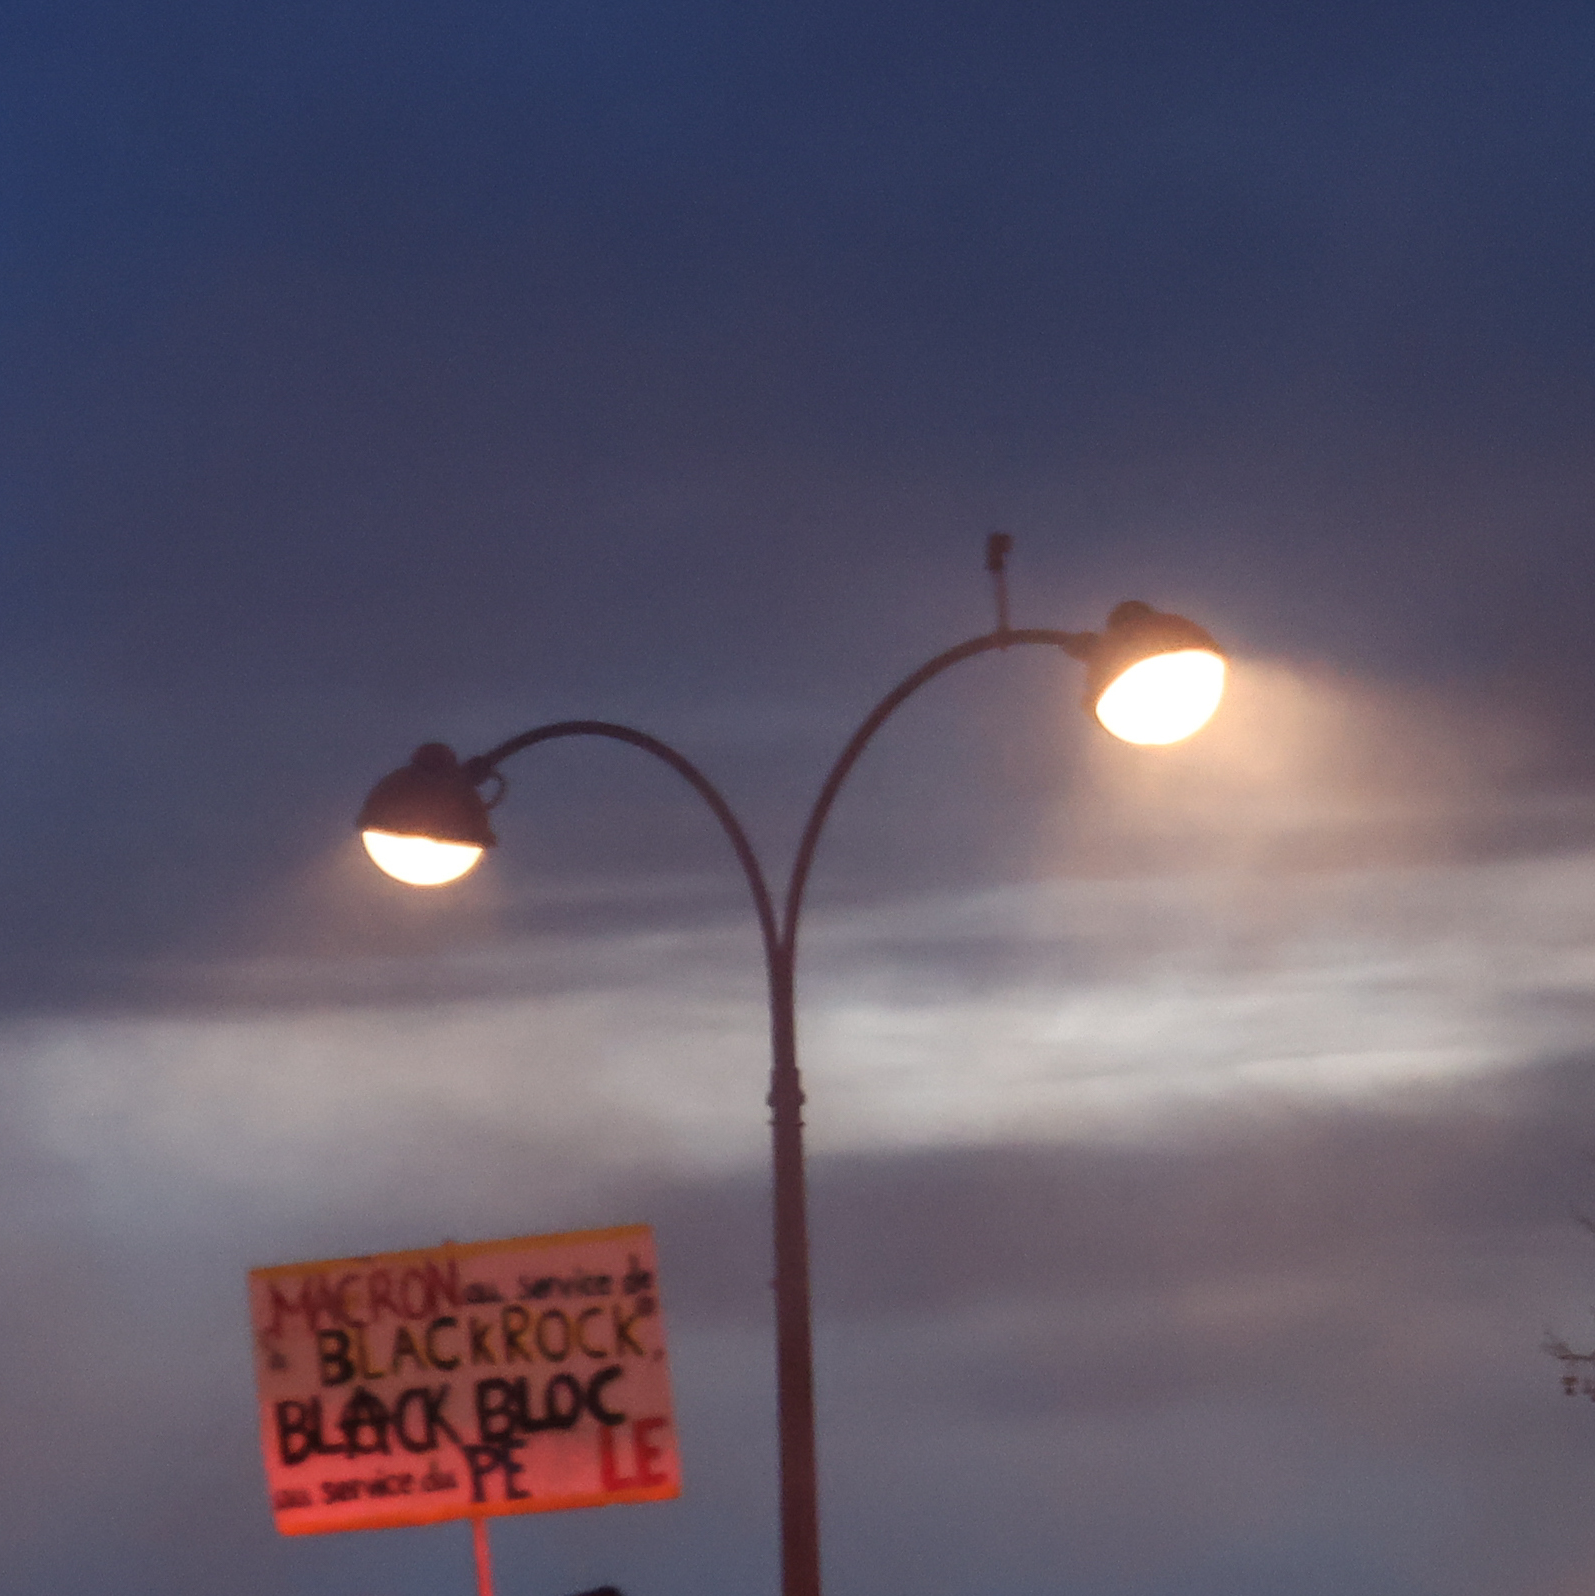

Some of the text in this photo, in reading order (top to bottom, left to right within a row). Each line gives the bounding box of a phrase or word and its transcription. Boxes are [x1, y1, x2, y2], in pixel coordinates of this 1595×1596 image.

[264, 1258, 460, 1337] MACRON
[317, 1303, 645, 1387] BLACKROCK
[276, 1365, 625, 1467] BLACK BLOC
